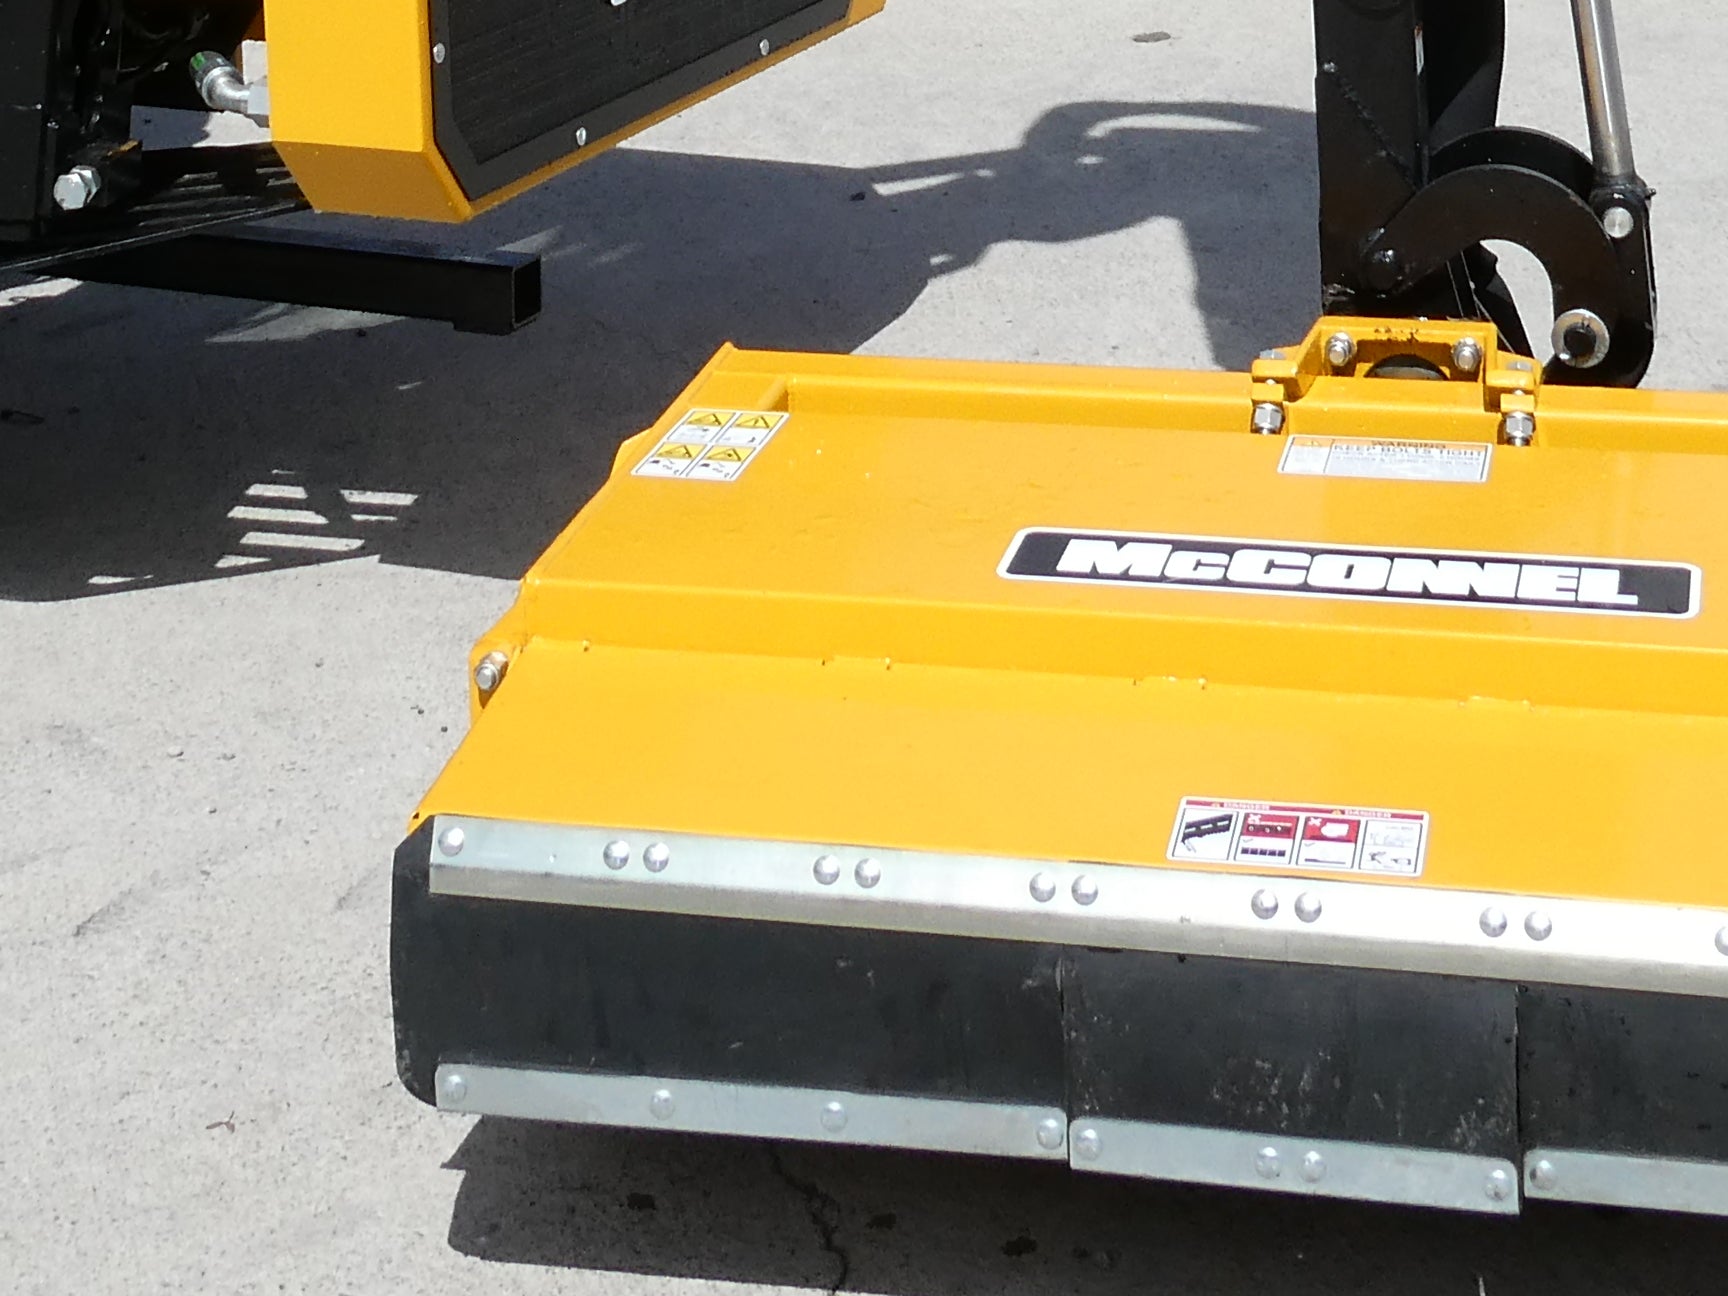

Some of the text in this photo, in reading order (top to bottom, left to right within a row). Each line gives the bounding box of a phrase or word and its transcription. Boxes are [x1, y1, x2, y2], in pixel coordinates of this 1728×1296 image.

[1333, 444, 1377, 453] KEEP
[1380, 446, 1432, 455] BOLTS
[1439, 448, 1482, 457] TIGHT
[1371, 439, 1447, 449] WARNING
[1056, 538, 1639, 606] McCONNEL
[1222, 801, 1392, 819] DANGER DANGER
